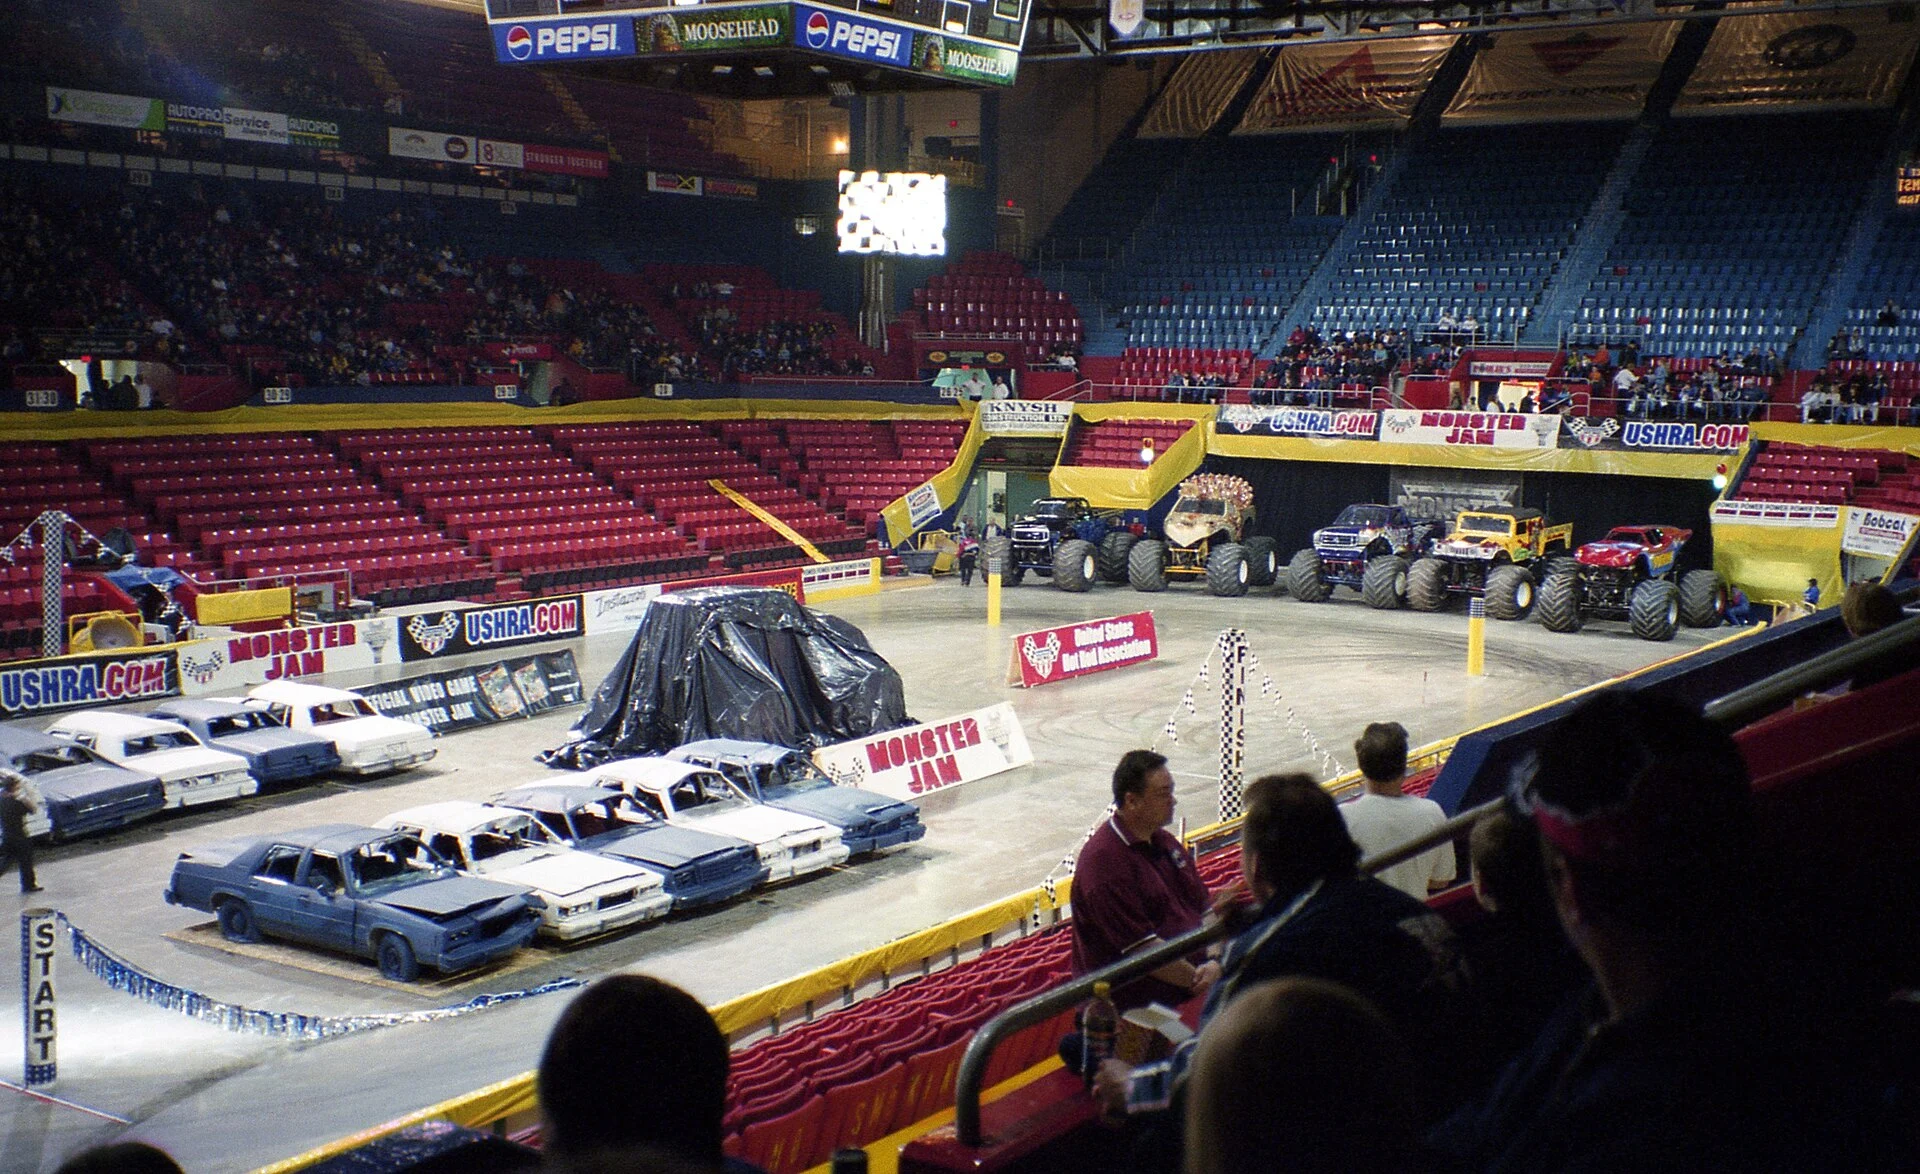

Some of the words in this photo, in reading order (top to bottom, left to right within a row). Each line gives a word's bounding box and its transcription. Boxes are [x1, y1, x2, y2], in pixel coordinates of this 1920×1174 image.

[537, 24, 618, 54] PEPSI
[684, 19, 779, 41] MOOSEHEAD
[831, 20, 901, 59] PEPSI
[947, 49, 1010, 77] MOOSEHEAD
[167, 103, 222, 122] AUTOPRO
[224, 113, 270, 129] Service
[288, 118, 338, 134] AUTOPRO
[990, 402, 1057, 413] KNYSH
[1270, 409, 1377, 435] USHRA.COM
[1420, 413, 1527, 431] MONSTER
[1623, 421, 1749, 450] USHRA.COM
[1445, 429, 1496, 445] JAM
[1863, 513, 1906, 532] Bobcat
[465, 600, 578, 646] USHRA.COM
[1073, 624, 1105, 648] United
[1105, 621, 1134, 641] States
[229, 623, 357, 663] MONSTER
[1062, 652, 1079, 673] Hot
[1079, 648, 1098, 669] Rod
[1098, 639, 1152, 665] Association
[265, 651, 326, 680] JAM
[0, 659, 168, 711] USHRA.COM
[408, 682, 446, 703] VIDEO
[446, 676, 478, 697] GAME
[450, 701, 476, 721] JAM
[1236, 645, 1248, 768] FINISH
[865, 717, 982, 774] MONSTER
[908, 754, 963, 794] JAM
[33, 923, 54, 1060] START
